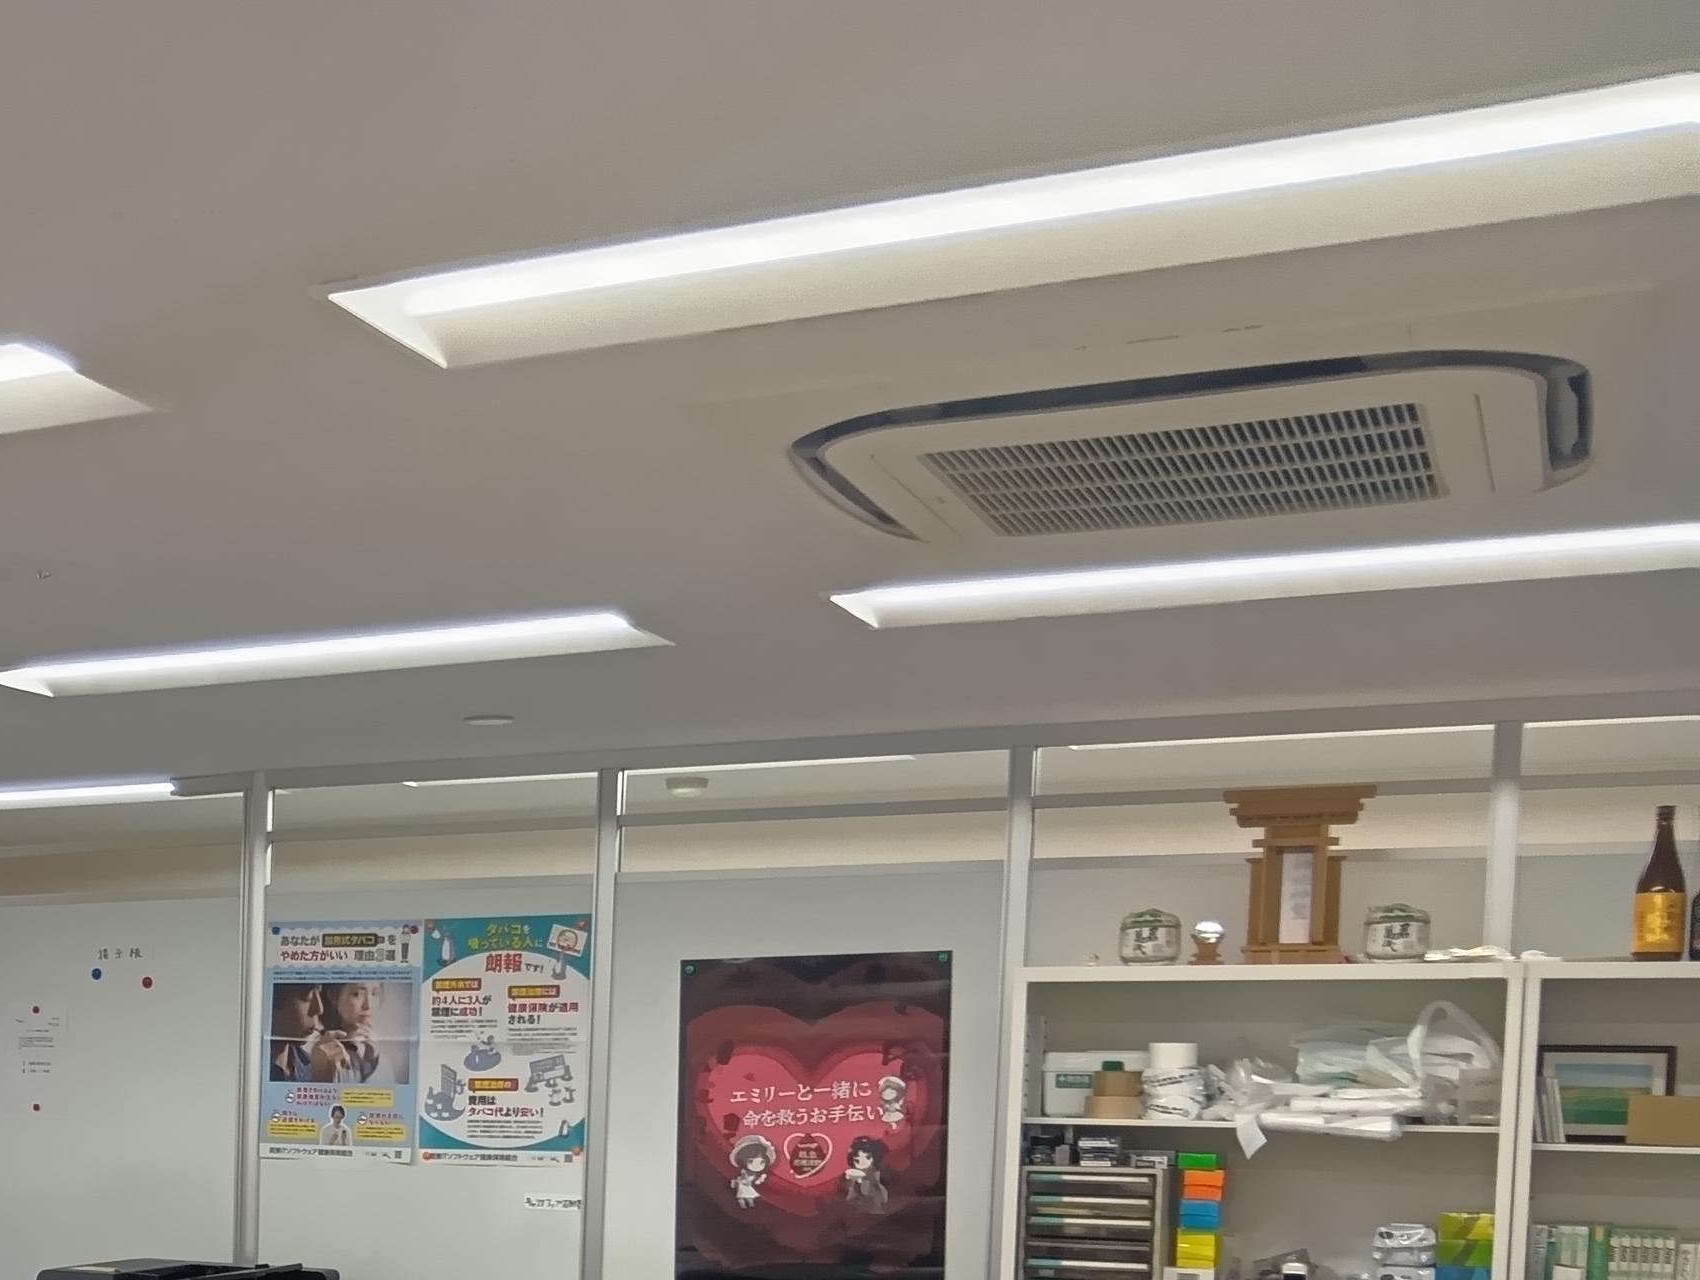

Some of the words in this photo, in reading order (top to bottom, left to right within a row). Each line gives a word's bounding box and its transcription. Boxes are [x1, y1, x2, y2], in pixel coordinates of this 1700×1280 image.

[280, 935, 320, 946] あなたが
[280, 950, 349, 962] やめた方がいい
[729, 1081, 873, 1105] エミリーと一緒に
[468, 1096, 497, 1105] 費用は
[741, 1106, 883, 1128] 命を救うお手伝い
